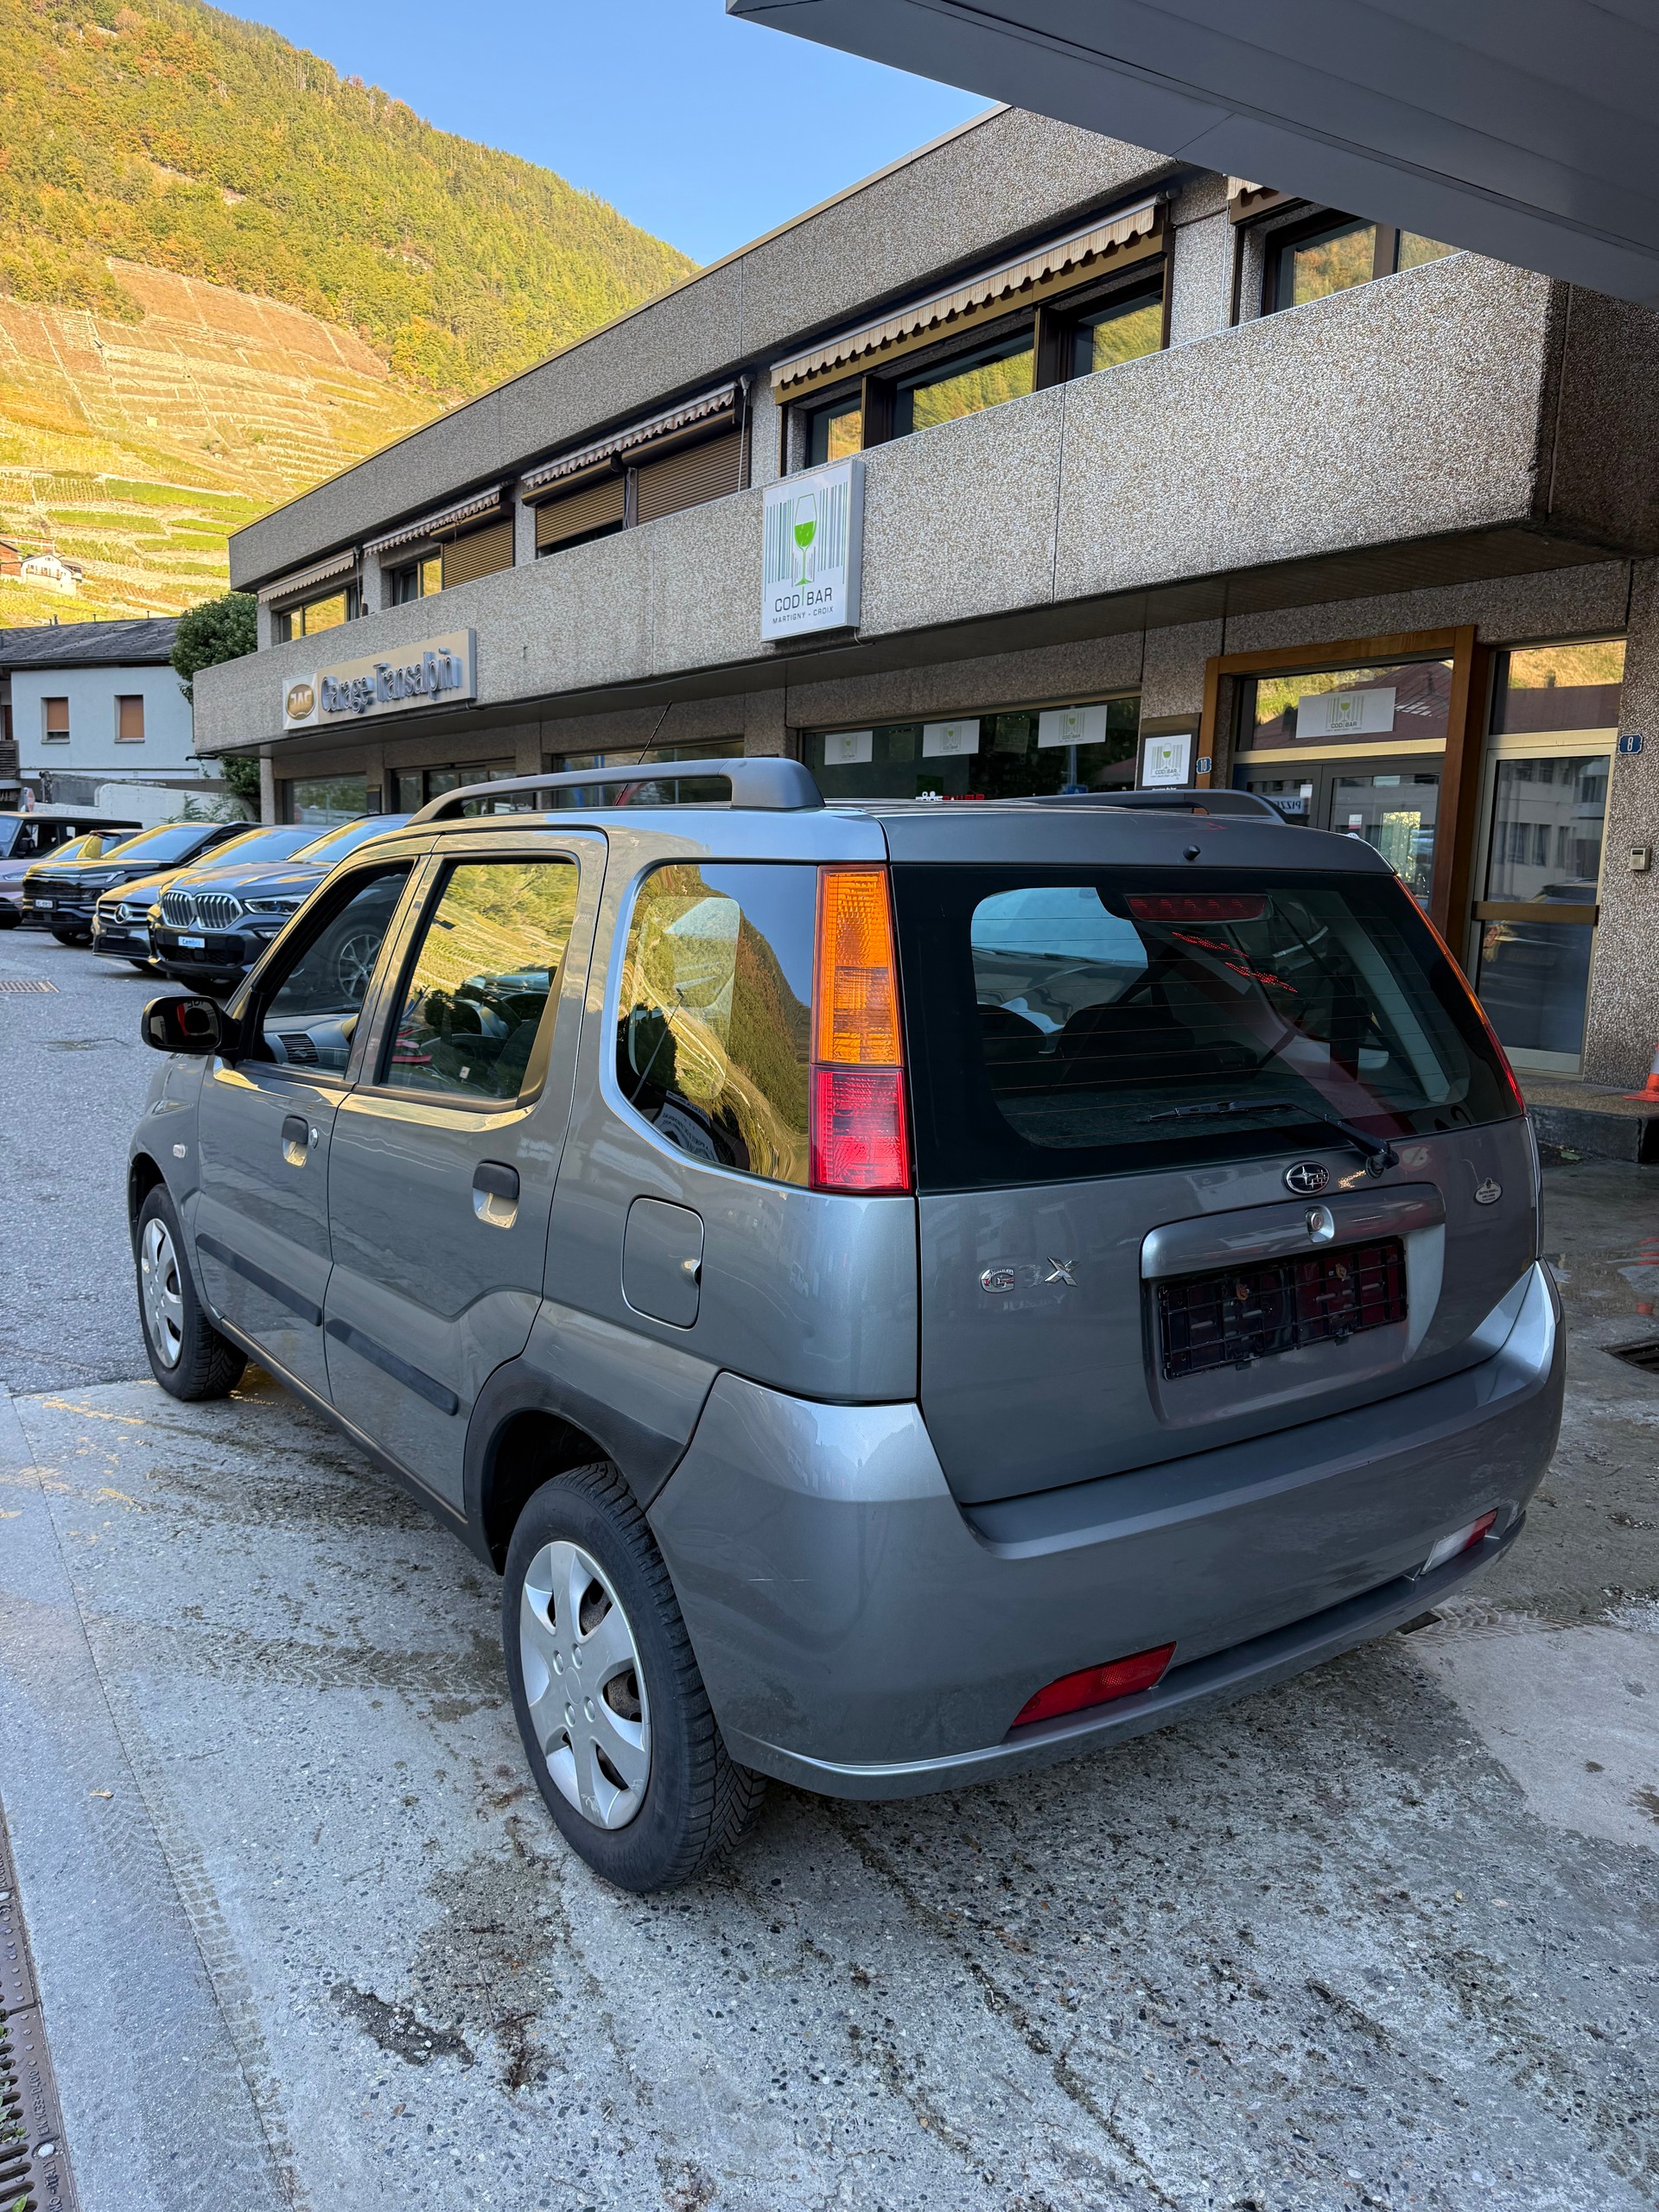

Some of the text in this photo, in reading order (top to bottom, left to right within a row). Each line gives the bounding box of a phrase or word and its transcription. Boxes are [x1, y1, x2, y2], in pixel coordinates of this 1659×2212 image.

[806, 587, 833, 606] BAR
[772, 611, 806, 624] MARTIGNY
[812, 606, 834, 616] CROIX
[321, 647, 461, 714] Garage Transalpin
[290, 689, 311, 707] JAC
[1627, 736, 1634, 752] 8
[1200, 759, 1207, 772] 10
[37, 2120, 49, 2136] EN
